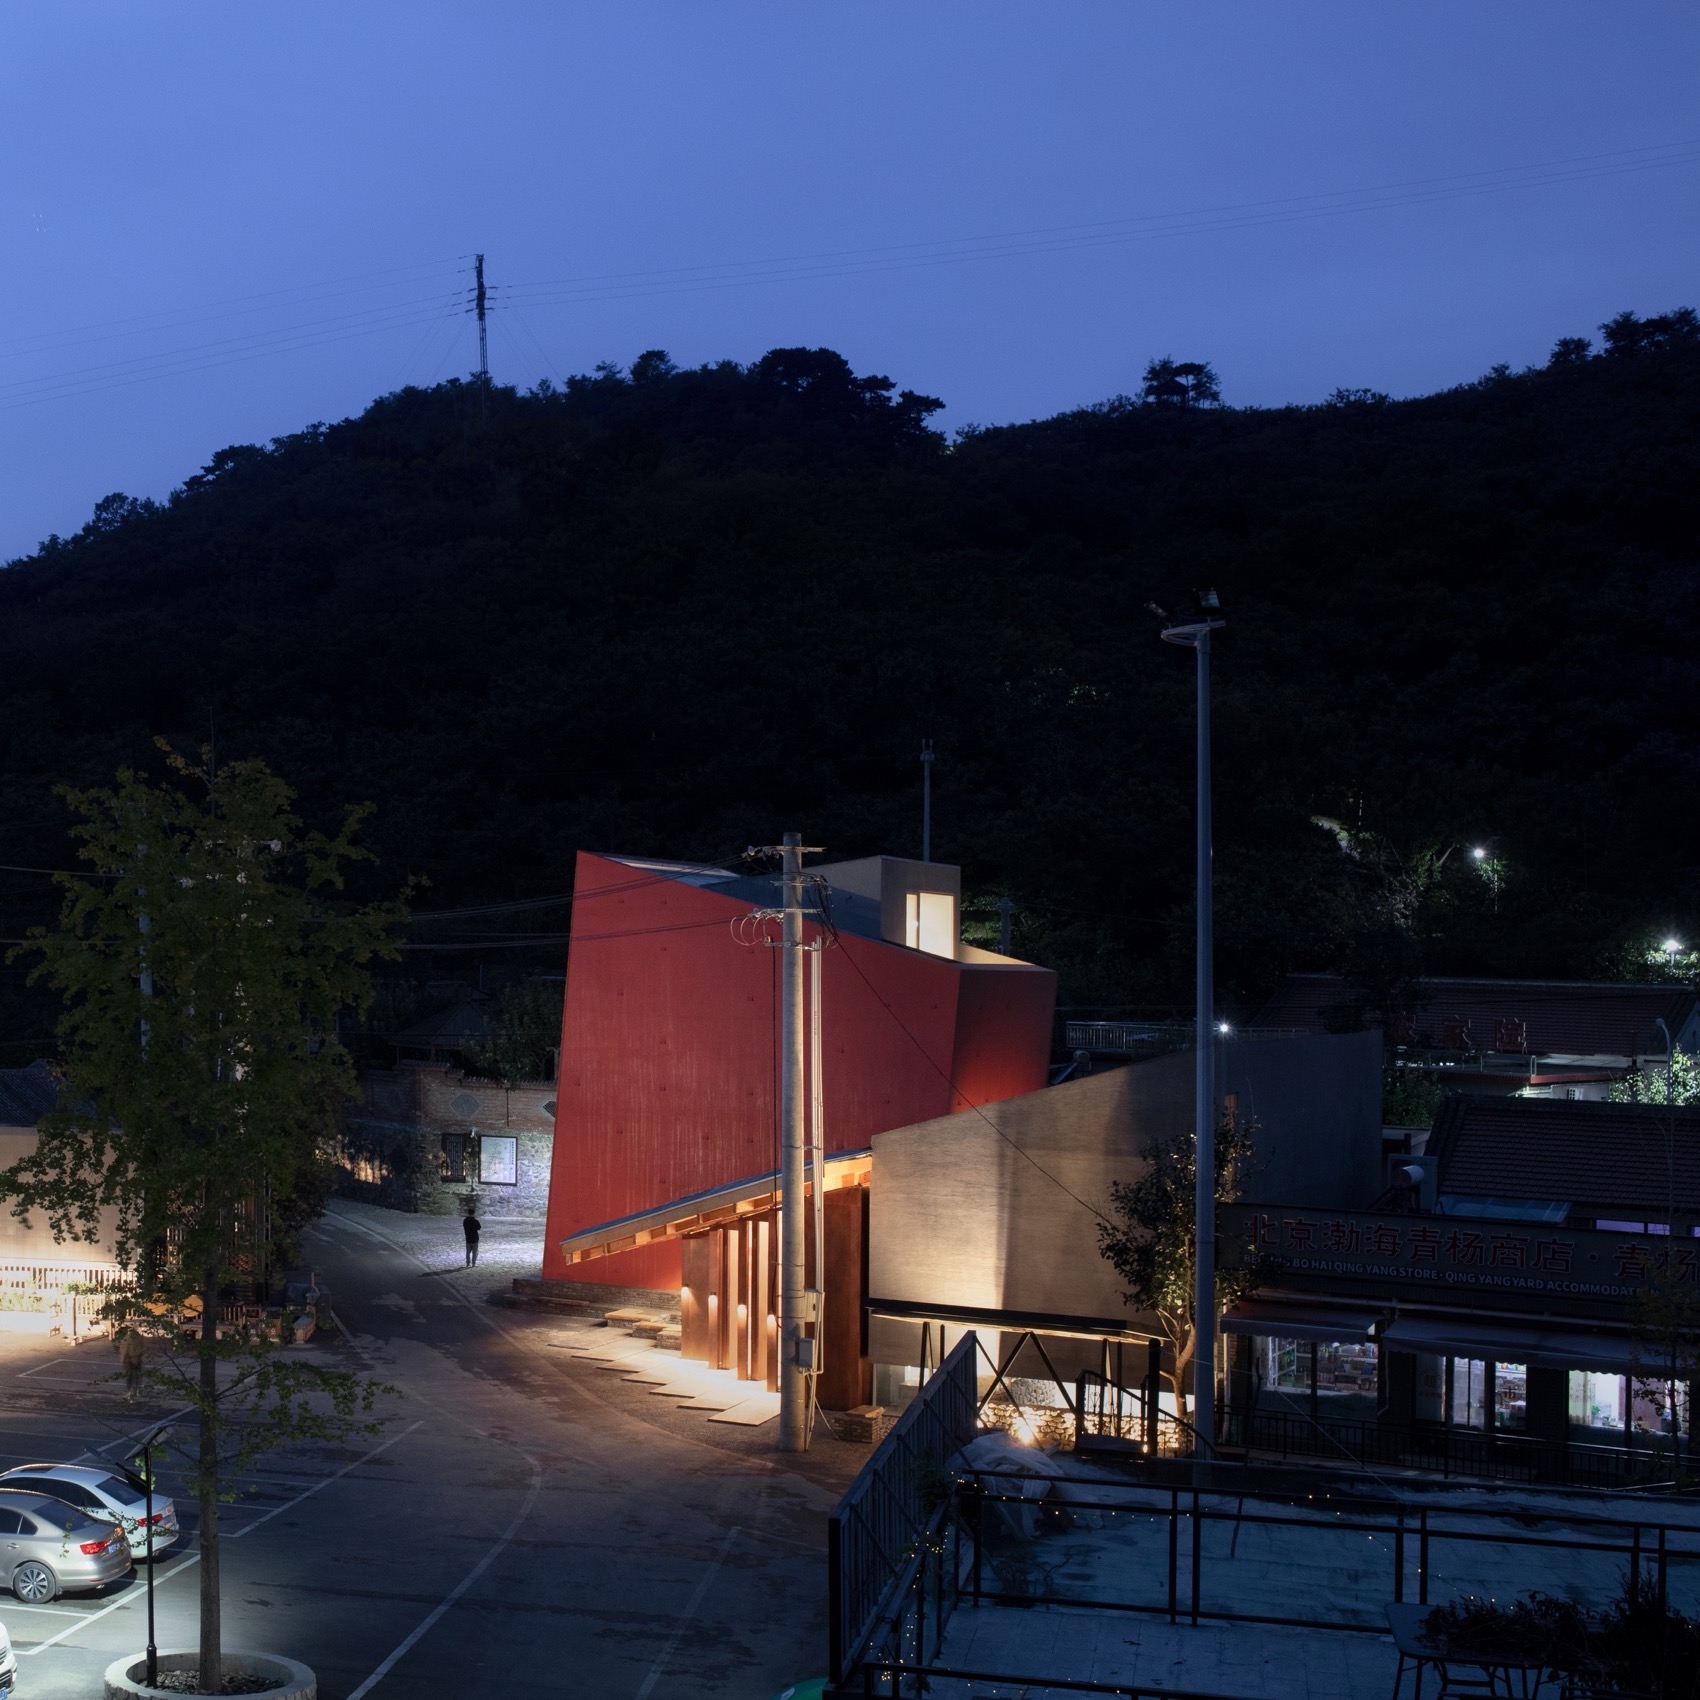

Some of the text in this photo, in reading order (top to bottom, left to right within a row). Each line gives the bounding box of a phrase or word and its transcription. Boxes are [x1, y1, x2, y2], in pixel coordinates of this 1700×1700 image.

[1293, 1258, 1309, 1268] BO
[1312, 1260, 1332, 1271] HAI
[1335, 1262, 1363, 1273] QING
[1366, 1264, 1398, 1276] YANG
[1399, 1267, 1439, 1280] STORE
[1446, 1271, 1476, 1283] QING
